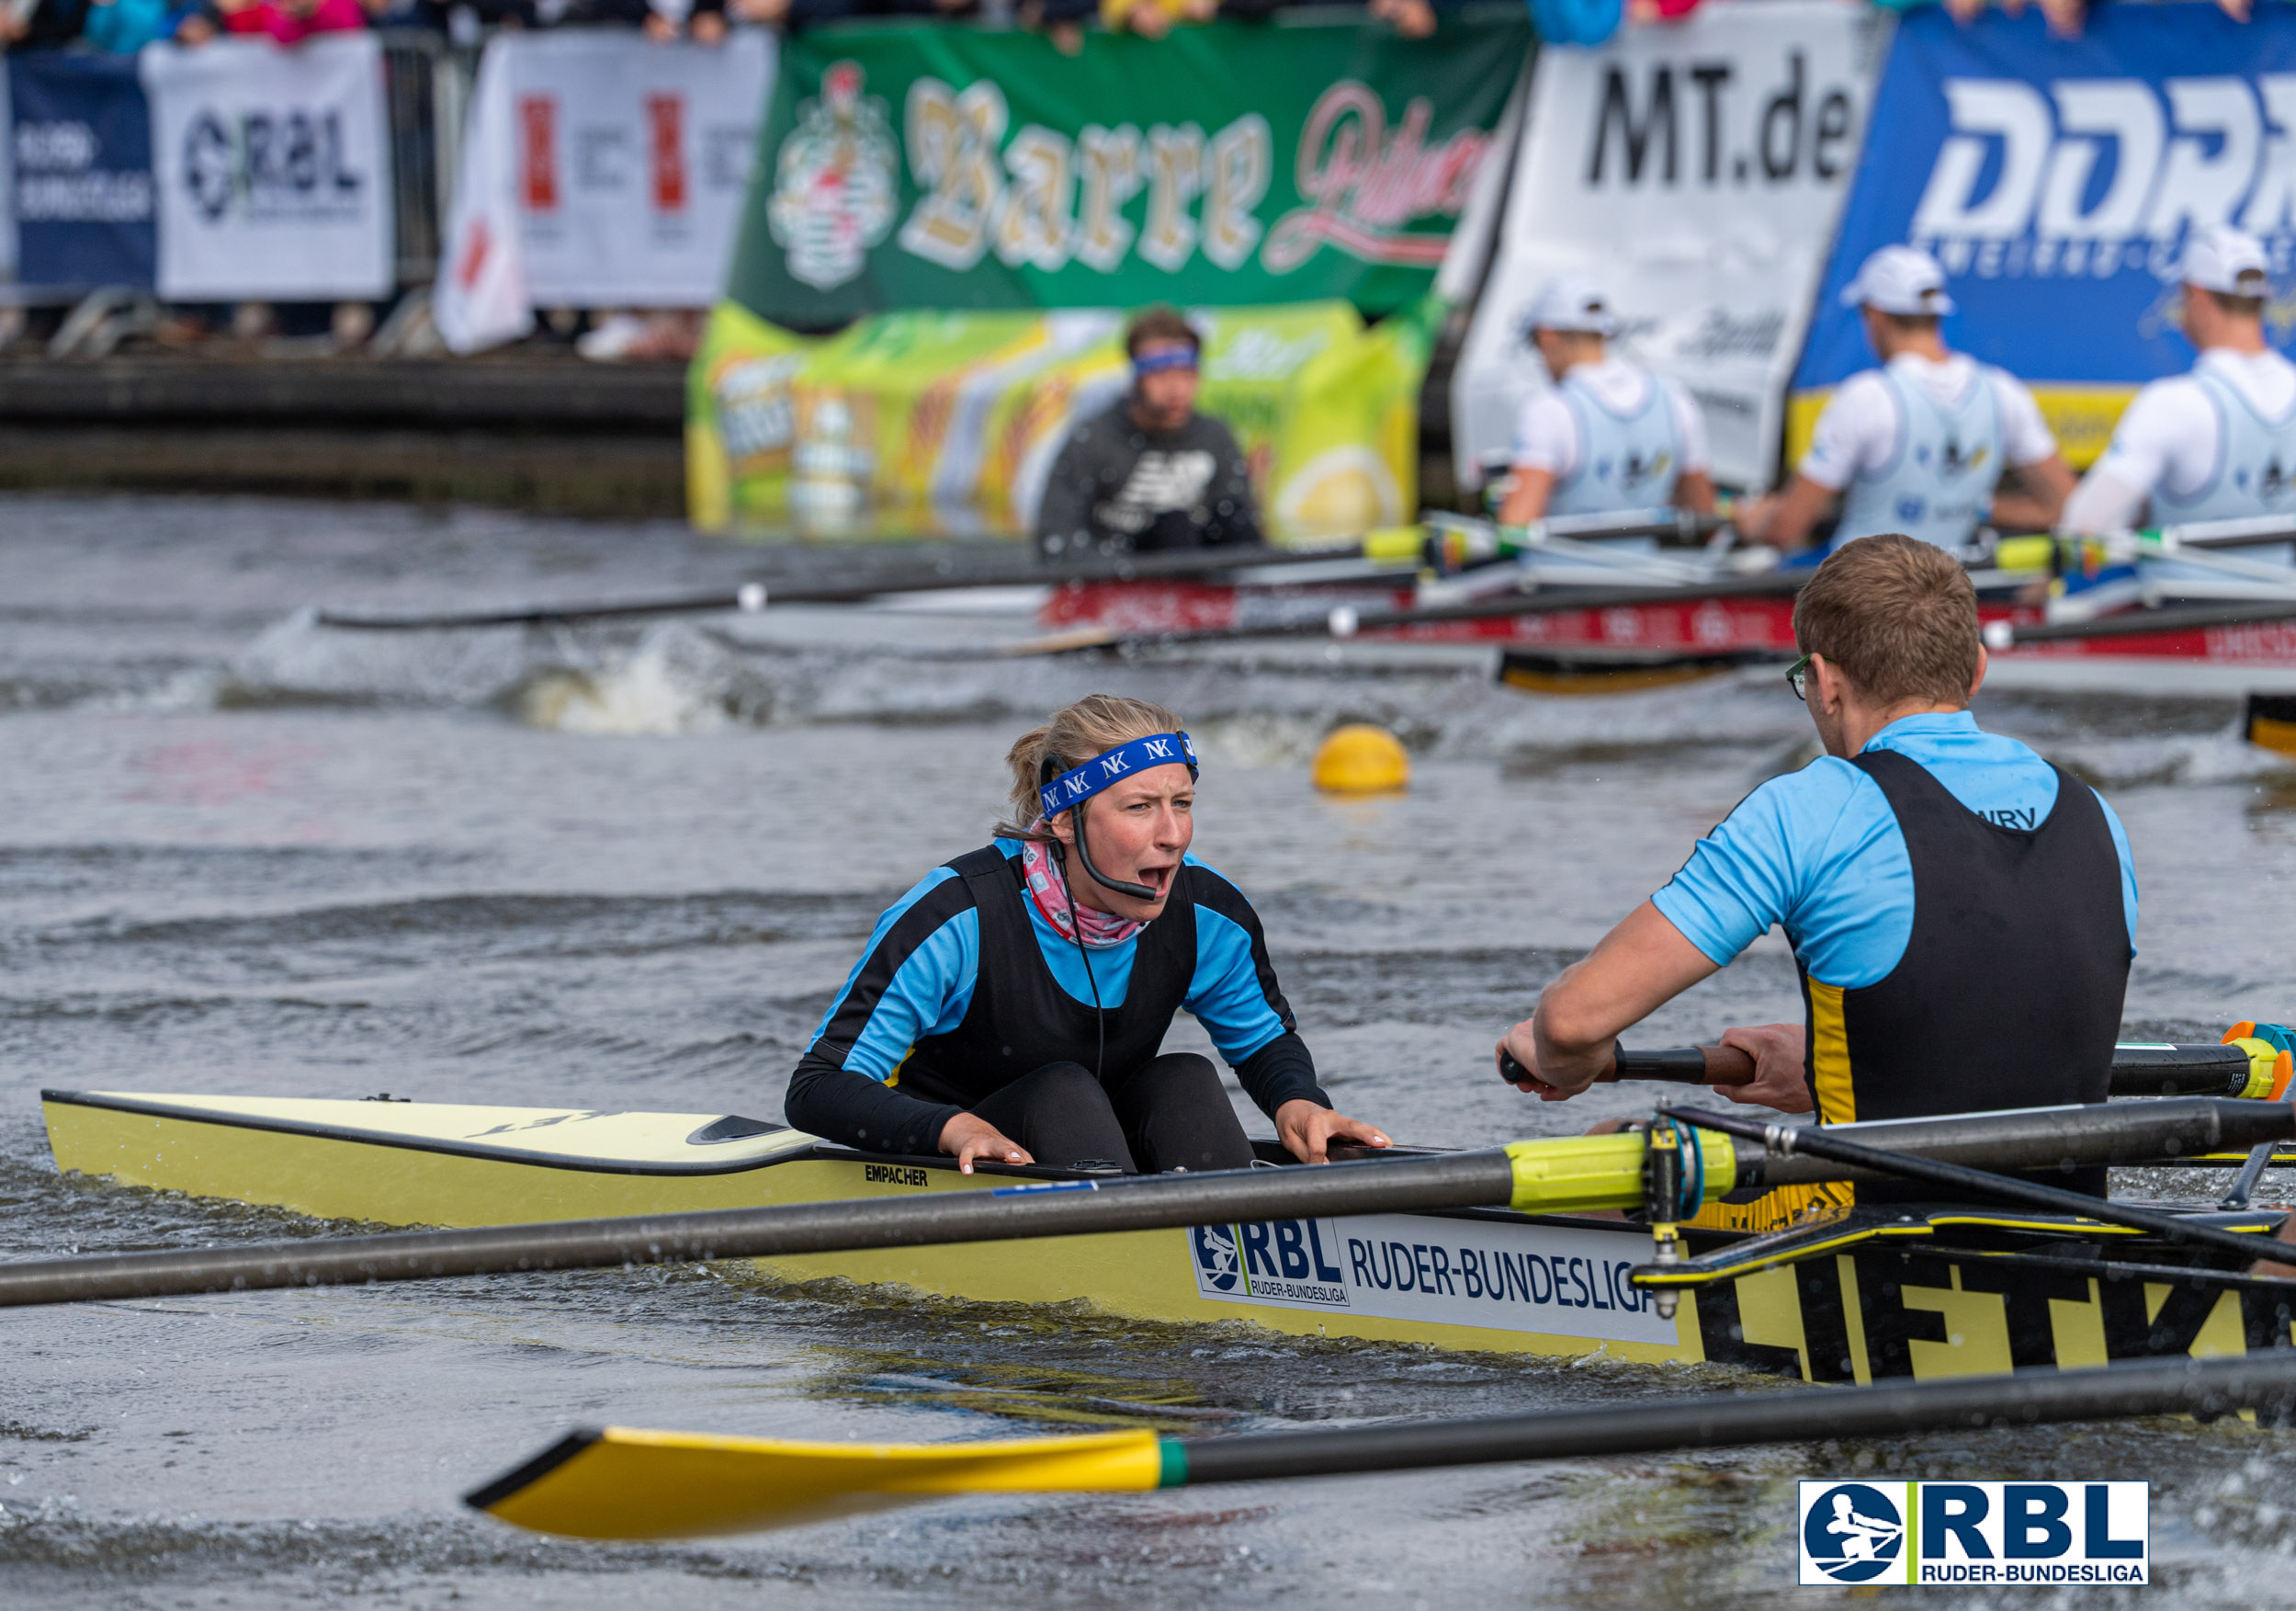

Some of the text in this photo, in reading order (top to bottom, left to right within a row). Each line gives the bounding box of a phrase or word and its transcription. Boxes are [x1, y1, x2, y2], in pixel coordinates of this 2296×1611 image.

[1585, 49, 1851, 183] MT.de
[899, 76, 1273, 274] Barre
[1063, 770, 1091, 800] NK
[1100, 750, 1131, 779] NK
[1143, 738, 1174, 760] NK
[865, 1164, 928, 1187] EMPACHER
[1240, 1217, 1342, 1283] RBL
[1347, 1237, 1656, 1313] RUDER-BUNDESLIG
[1250, 1279, 1347, 1303] RUDER-BUNDESLIGA
